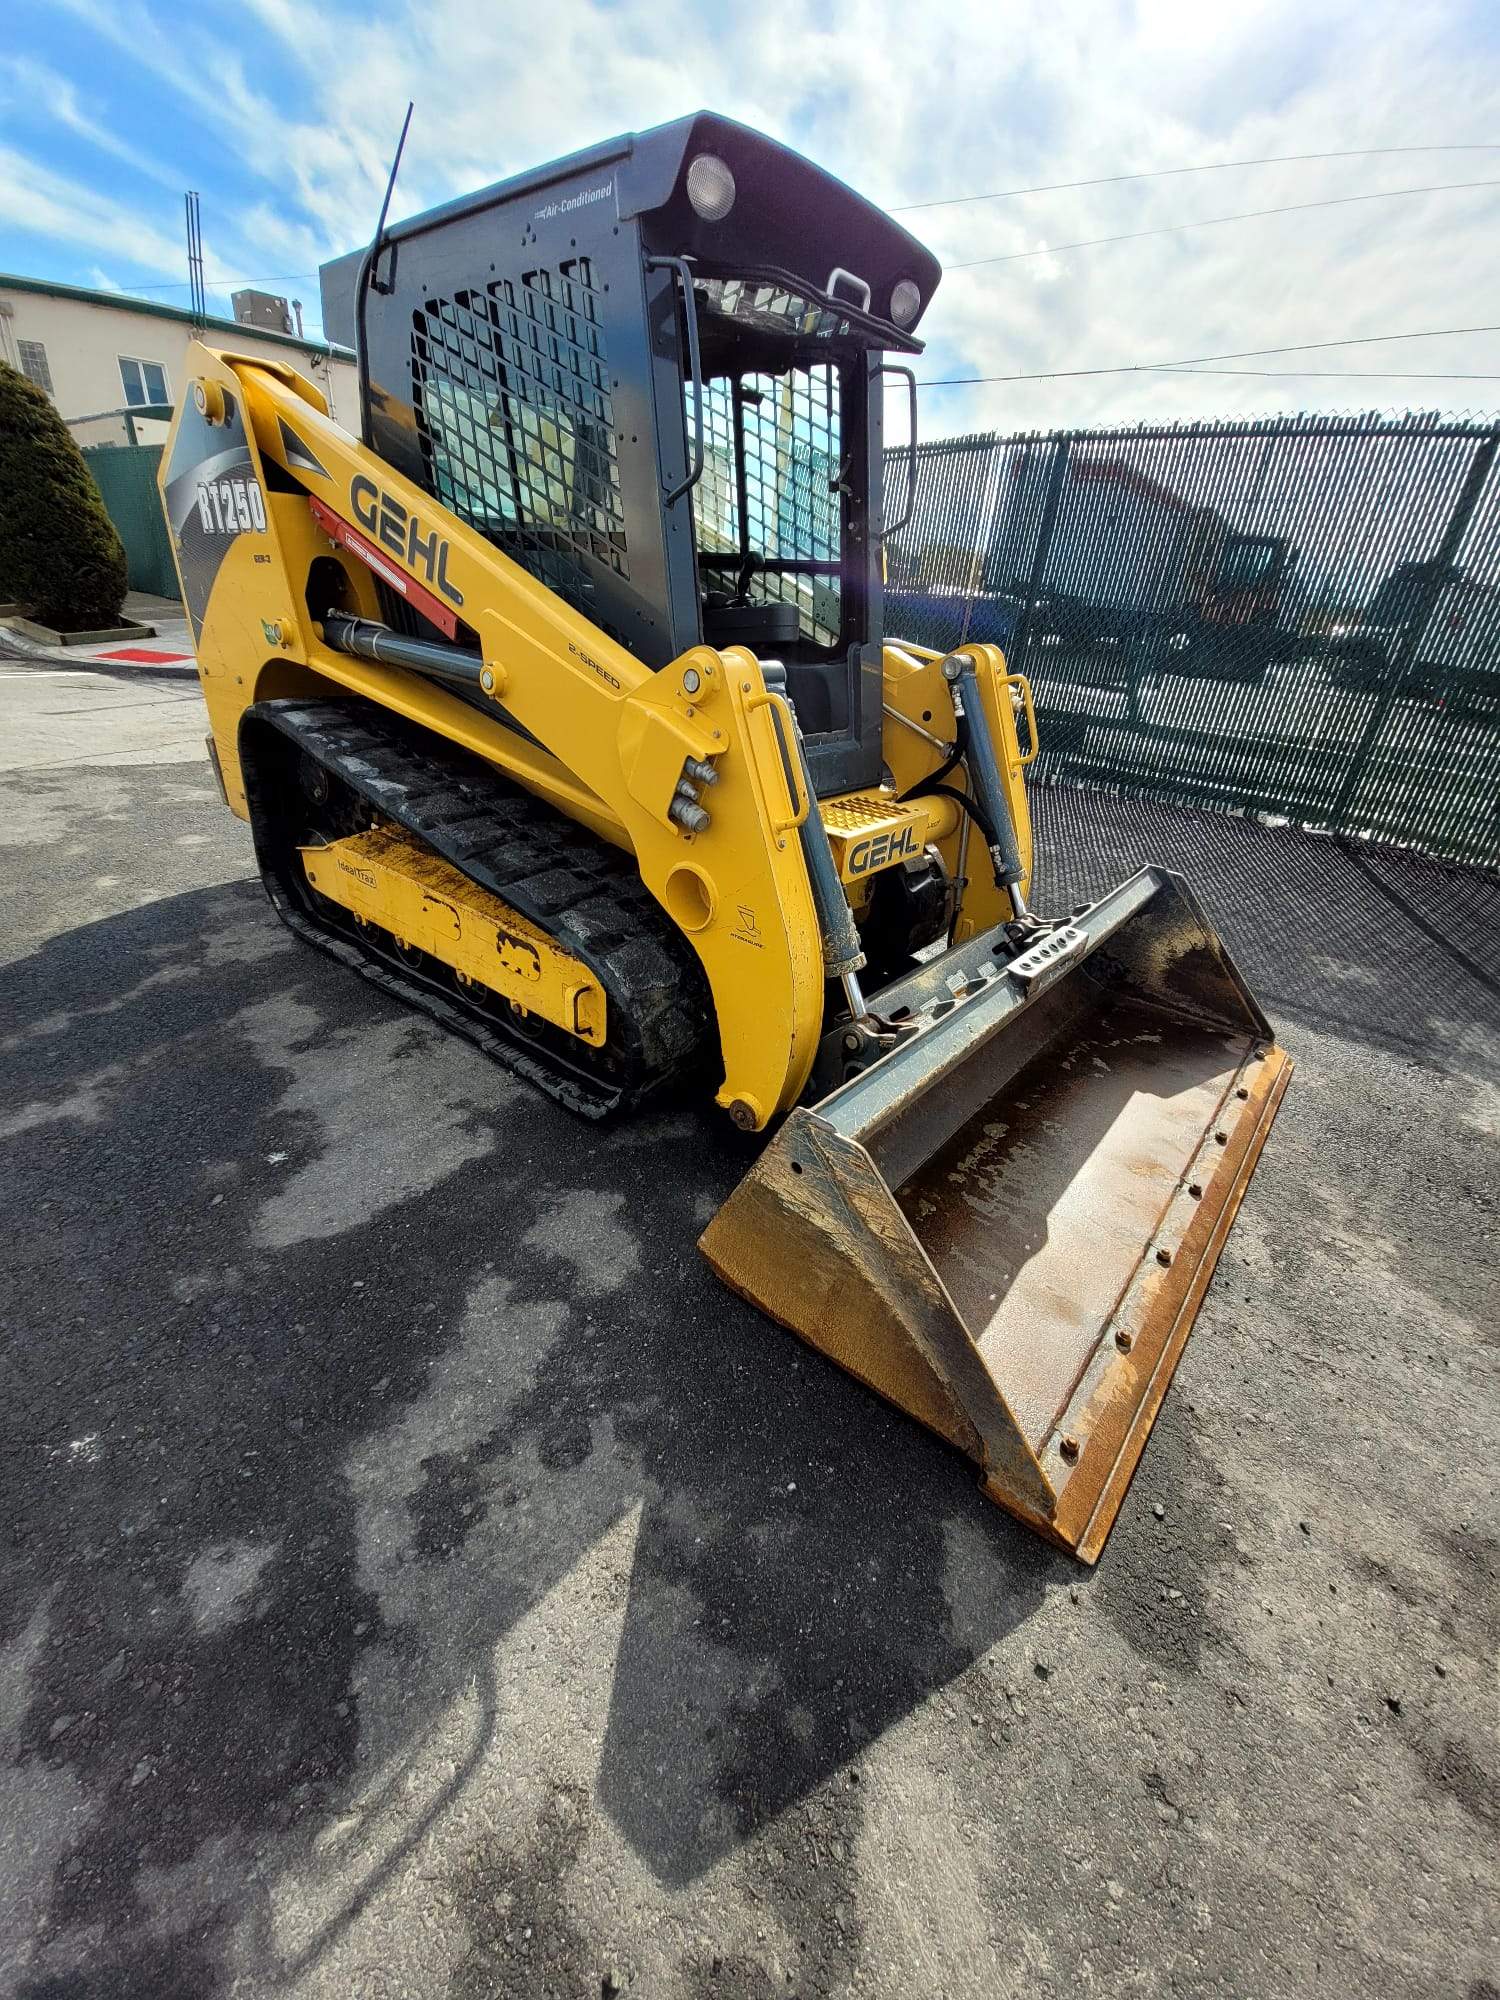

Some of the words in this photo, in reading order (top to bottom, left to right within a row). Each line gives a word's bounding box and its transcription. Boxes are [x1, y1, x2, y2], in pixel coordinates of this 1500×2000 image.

[545, 180, 613, 218] Air-Conditioned
[197, 478, 267, 534] RT250
[350, 473, 464, 606] GEHL
[567, 642, 621, 690] 2-SPEED
[849, 825, 920, 875] GEHL
